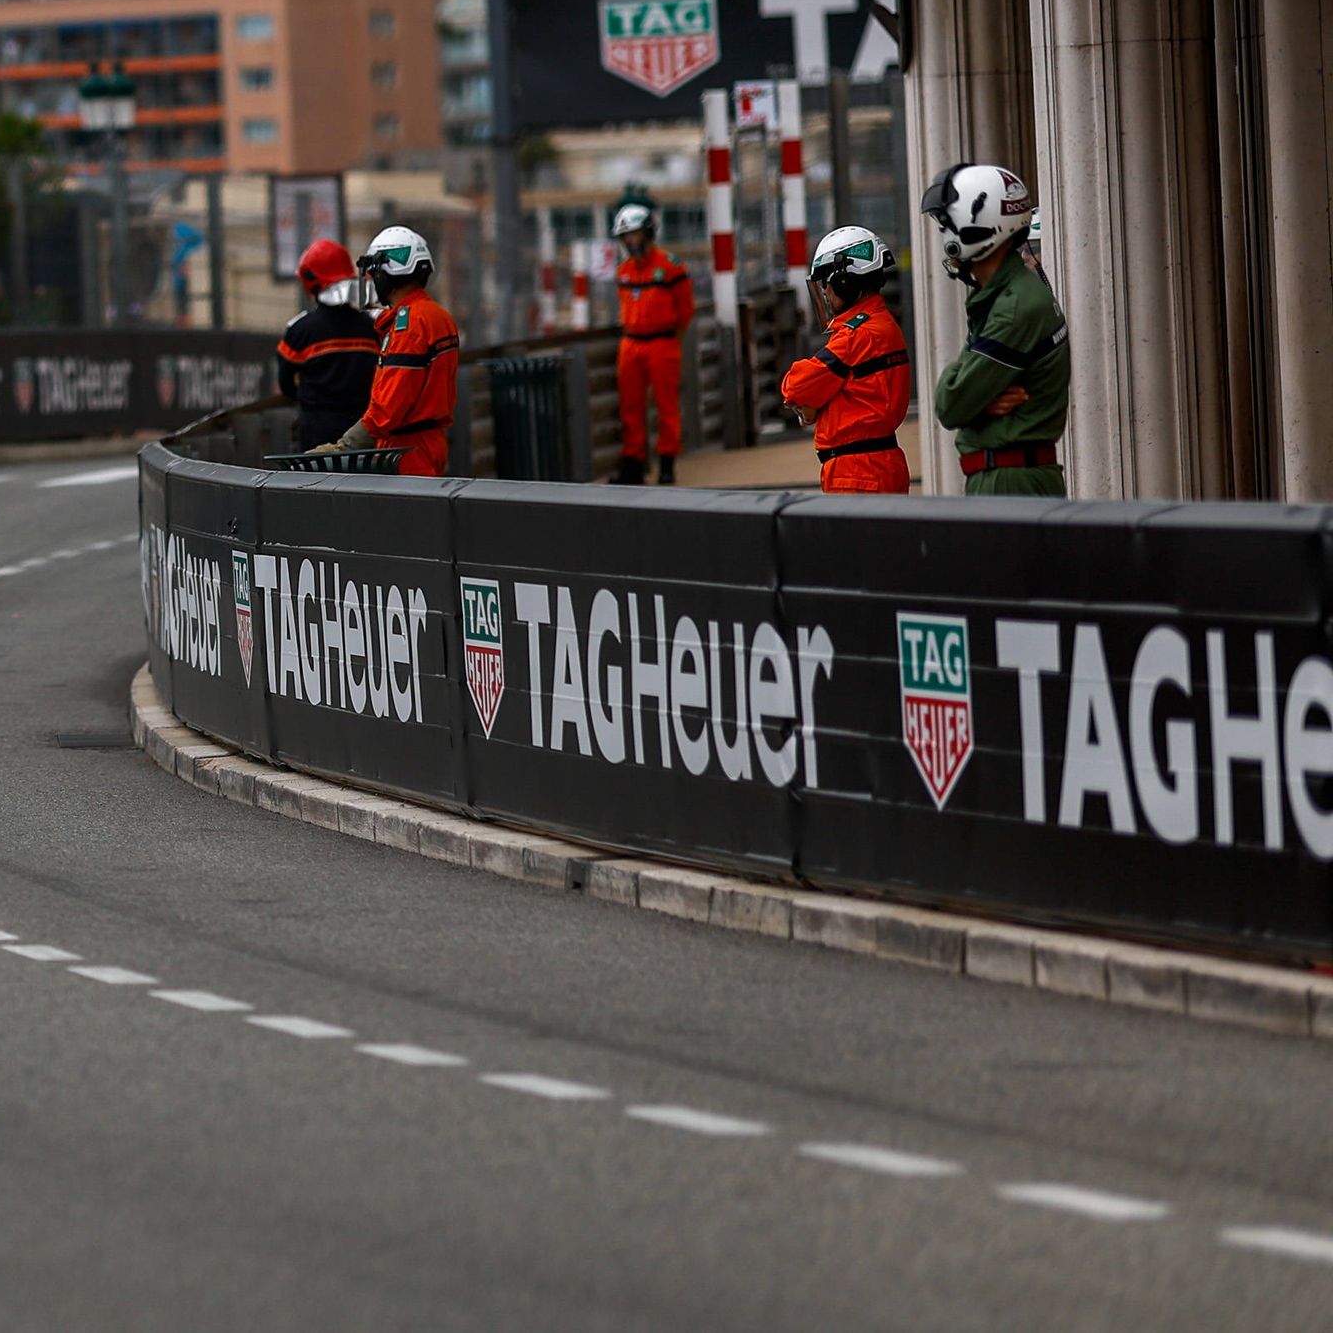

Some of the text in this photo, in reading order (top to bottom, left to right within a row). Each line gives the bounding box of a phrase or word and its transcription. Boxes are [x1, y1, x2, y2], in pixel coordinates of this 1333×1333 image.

[608, 0, 706, 34] TAG
[156, 527, 222, 677] TAGHeuer
[234, 561, 250, 602] TAG
[464, 589, 499, 638] TAG
[253, 554, 427, 724] TAGHeuer
[903, 628, 964, 688] TAG
[467, 651, 502, 723] HEUER
[514, 581, 833, 789] TAGHeuer
[905, 702, 967, 788] HEUER
